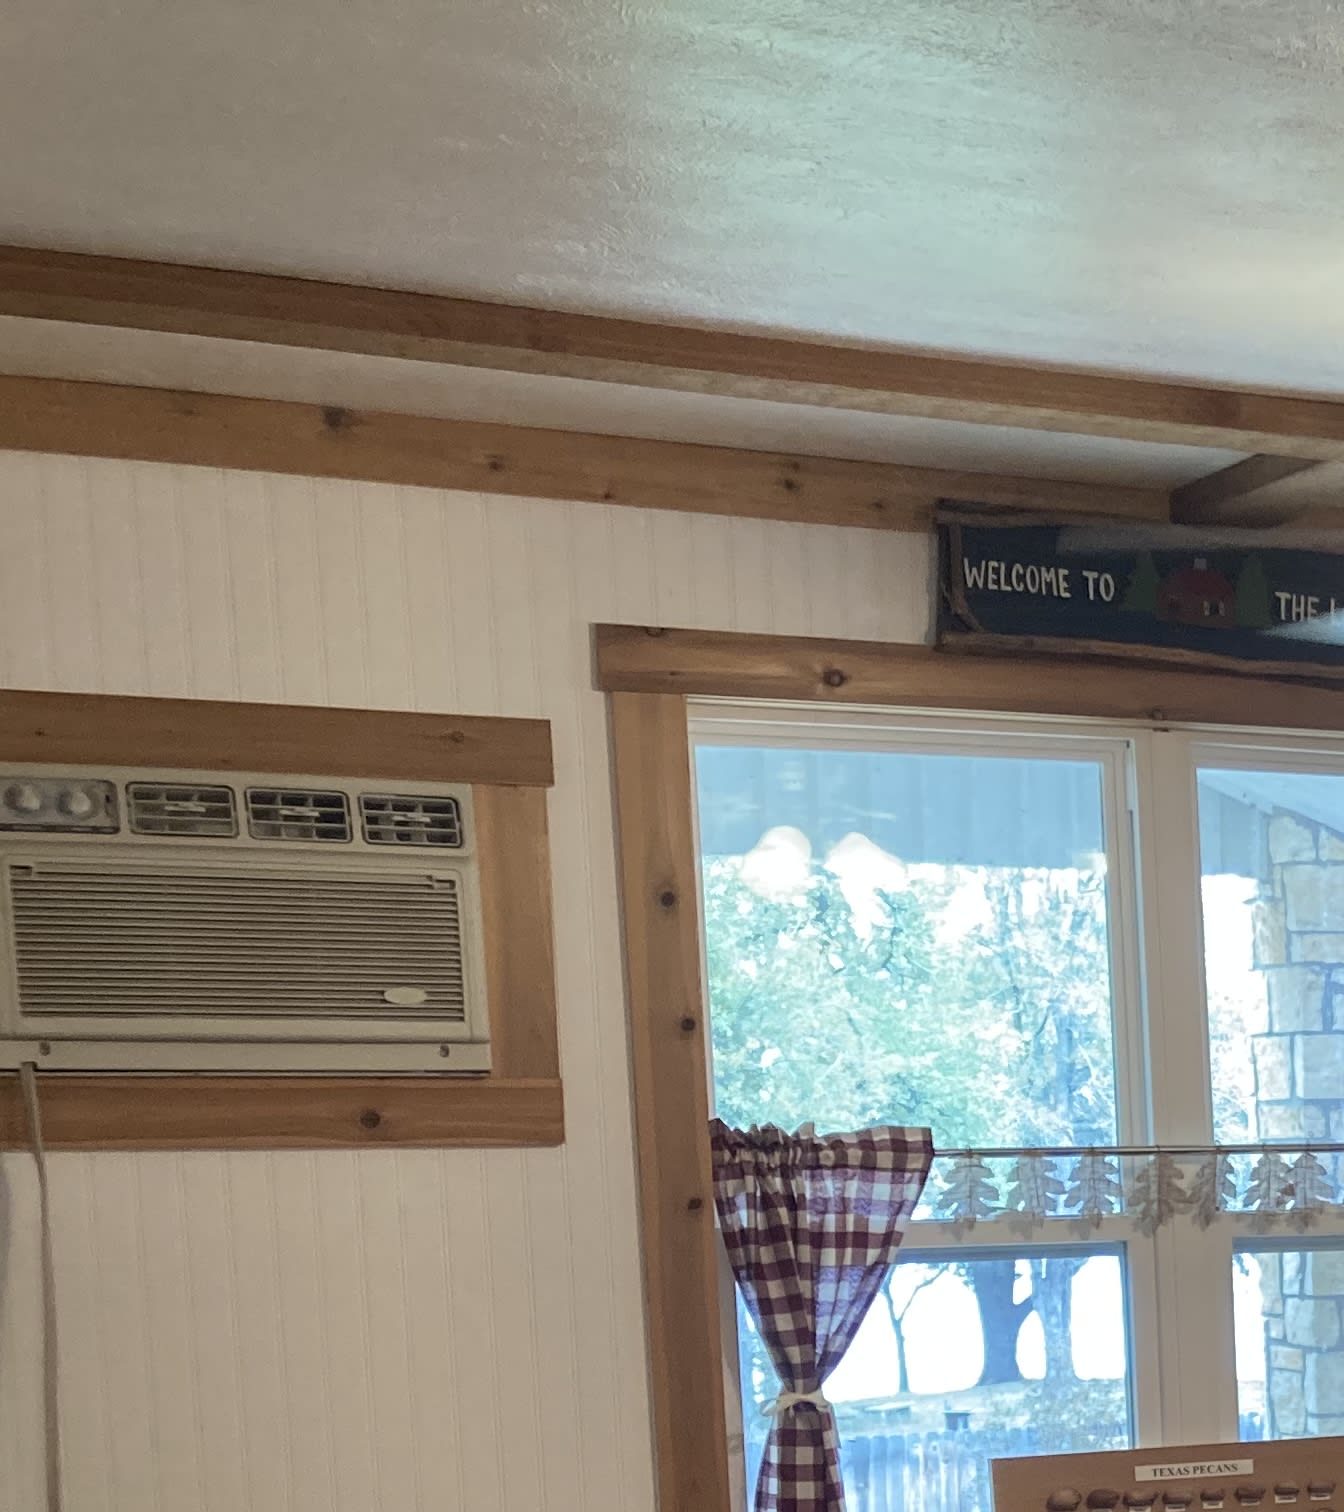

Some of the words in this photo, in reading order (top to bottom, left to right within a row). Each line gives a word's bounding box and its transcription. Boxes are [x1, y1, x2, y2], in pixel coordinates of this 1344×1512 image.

[963, 558, 1071, 598] WELCOME
[1082, 569, 1116, 602] TO
[1275, 591, 1321, 622] THE
[1151, 1465, 1190, 1478] TEXAS
[1193, 1462, 1239, 1476] PECANS
